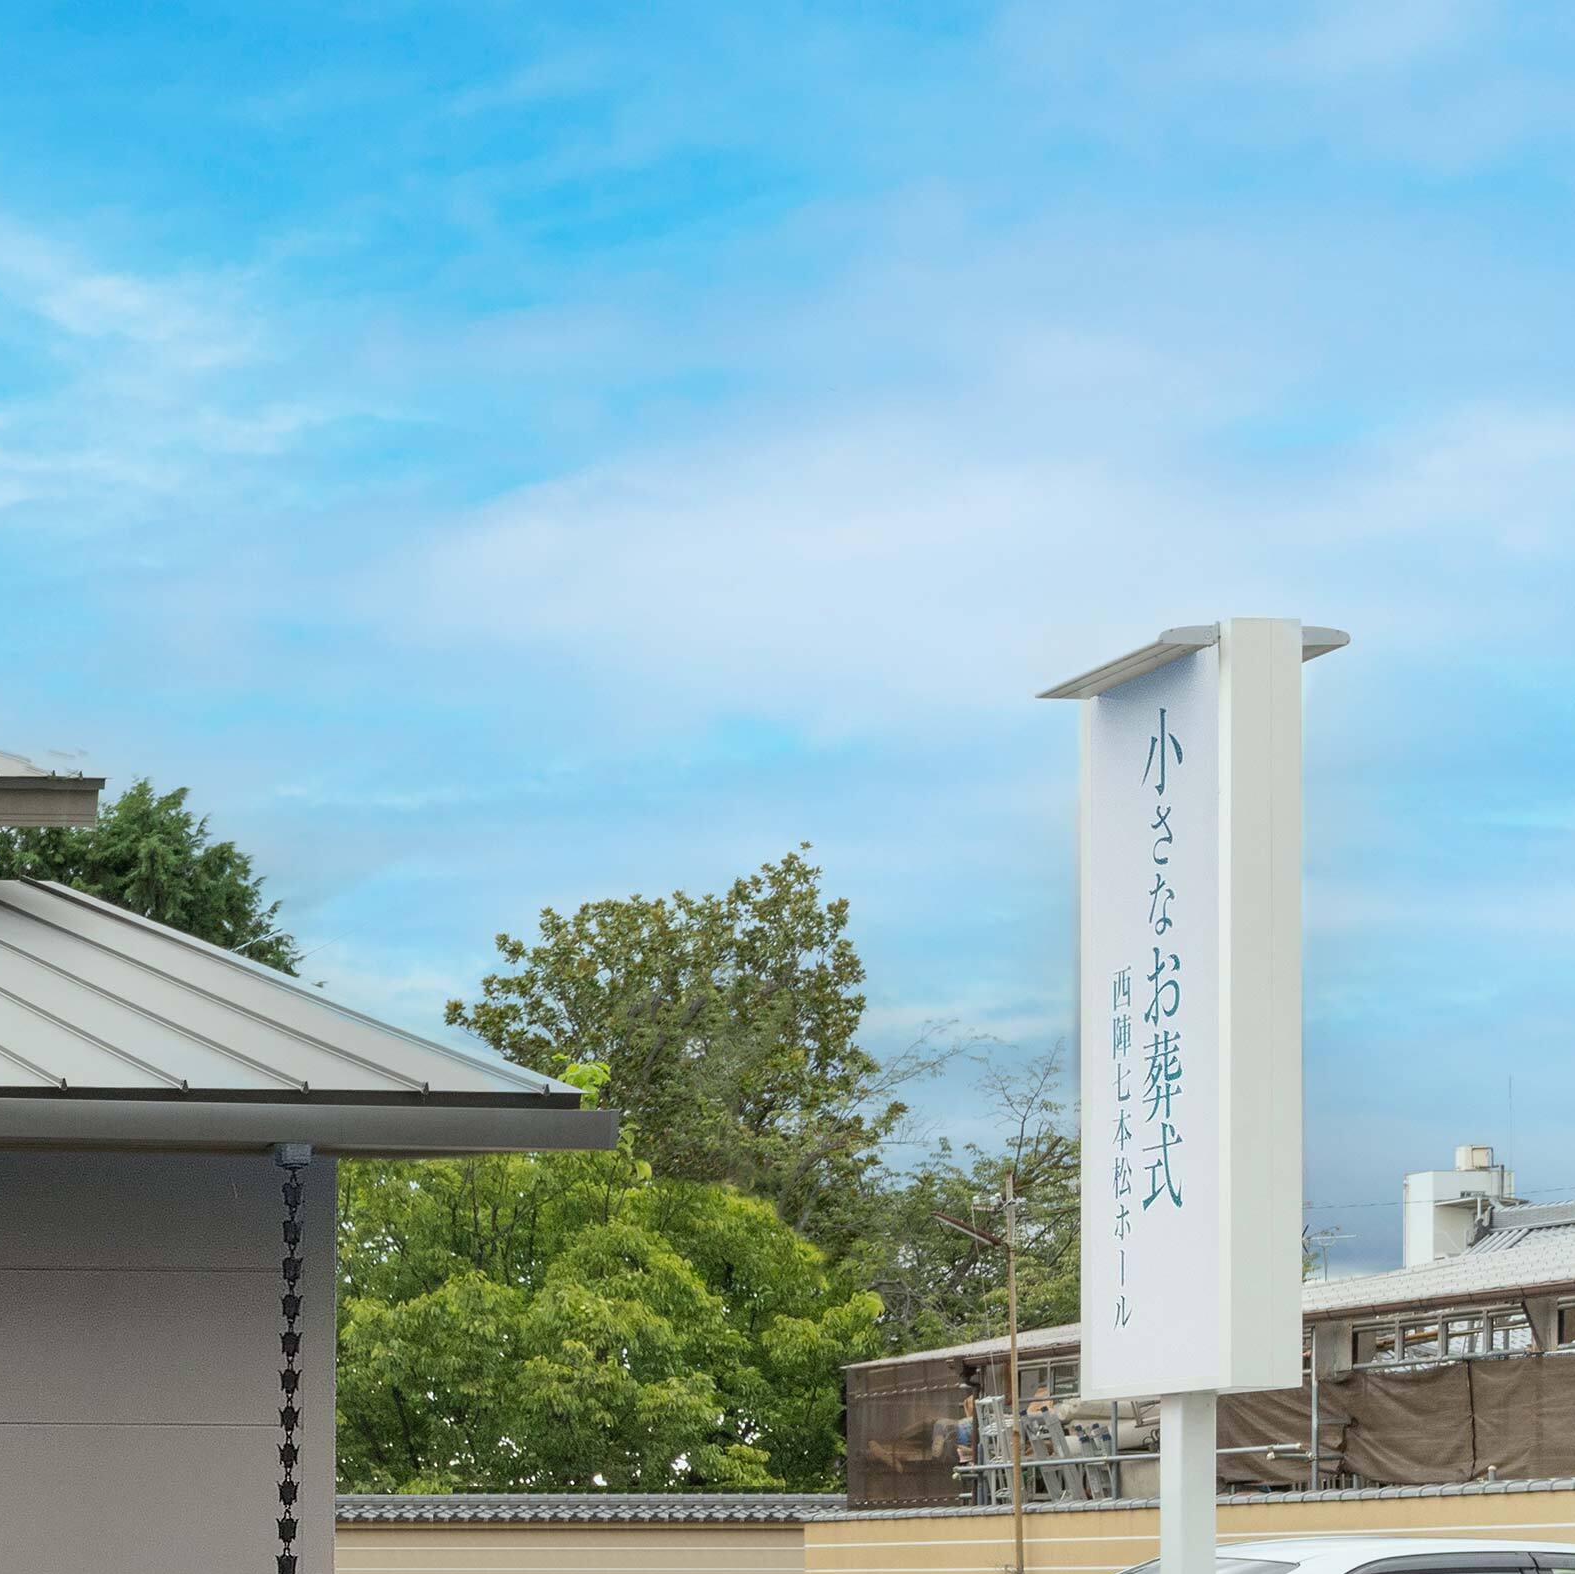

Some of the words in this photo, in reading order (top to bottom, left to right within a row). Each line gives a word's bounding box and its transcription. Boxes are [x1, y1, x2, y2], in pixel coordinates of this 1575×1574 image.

[1112, 966, 1132, 1330] 西陣七本松ホール
[1142, 707, 1183, 1211] 小さなお葬式
